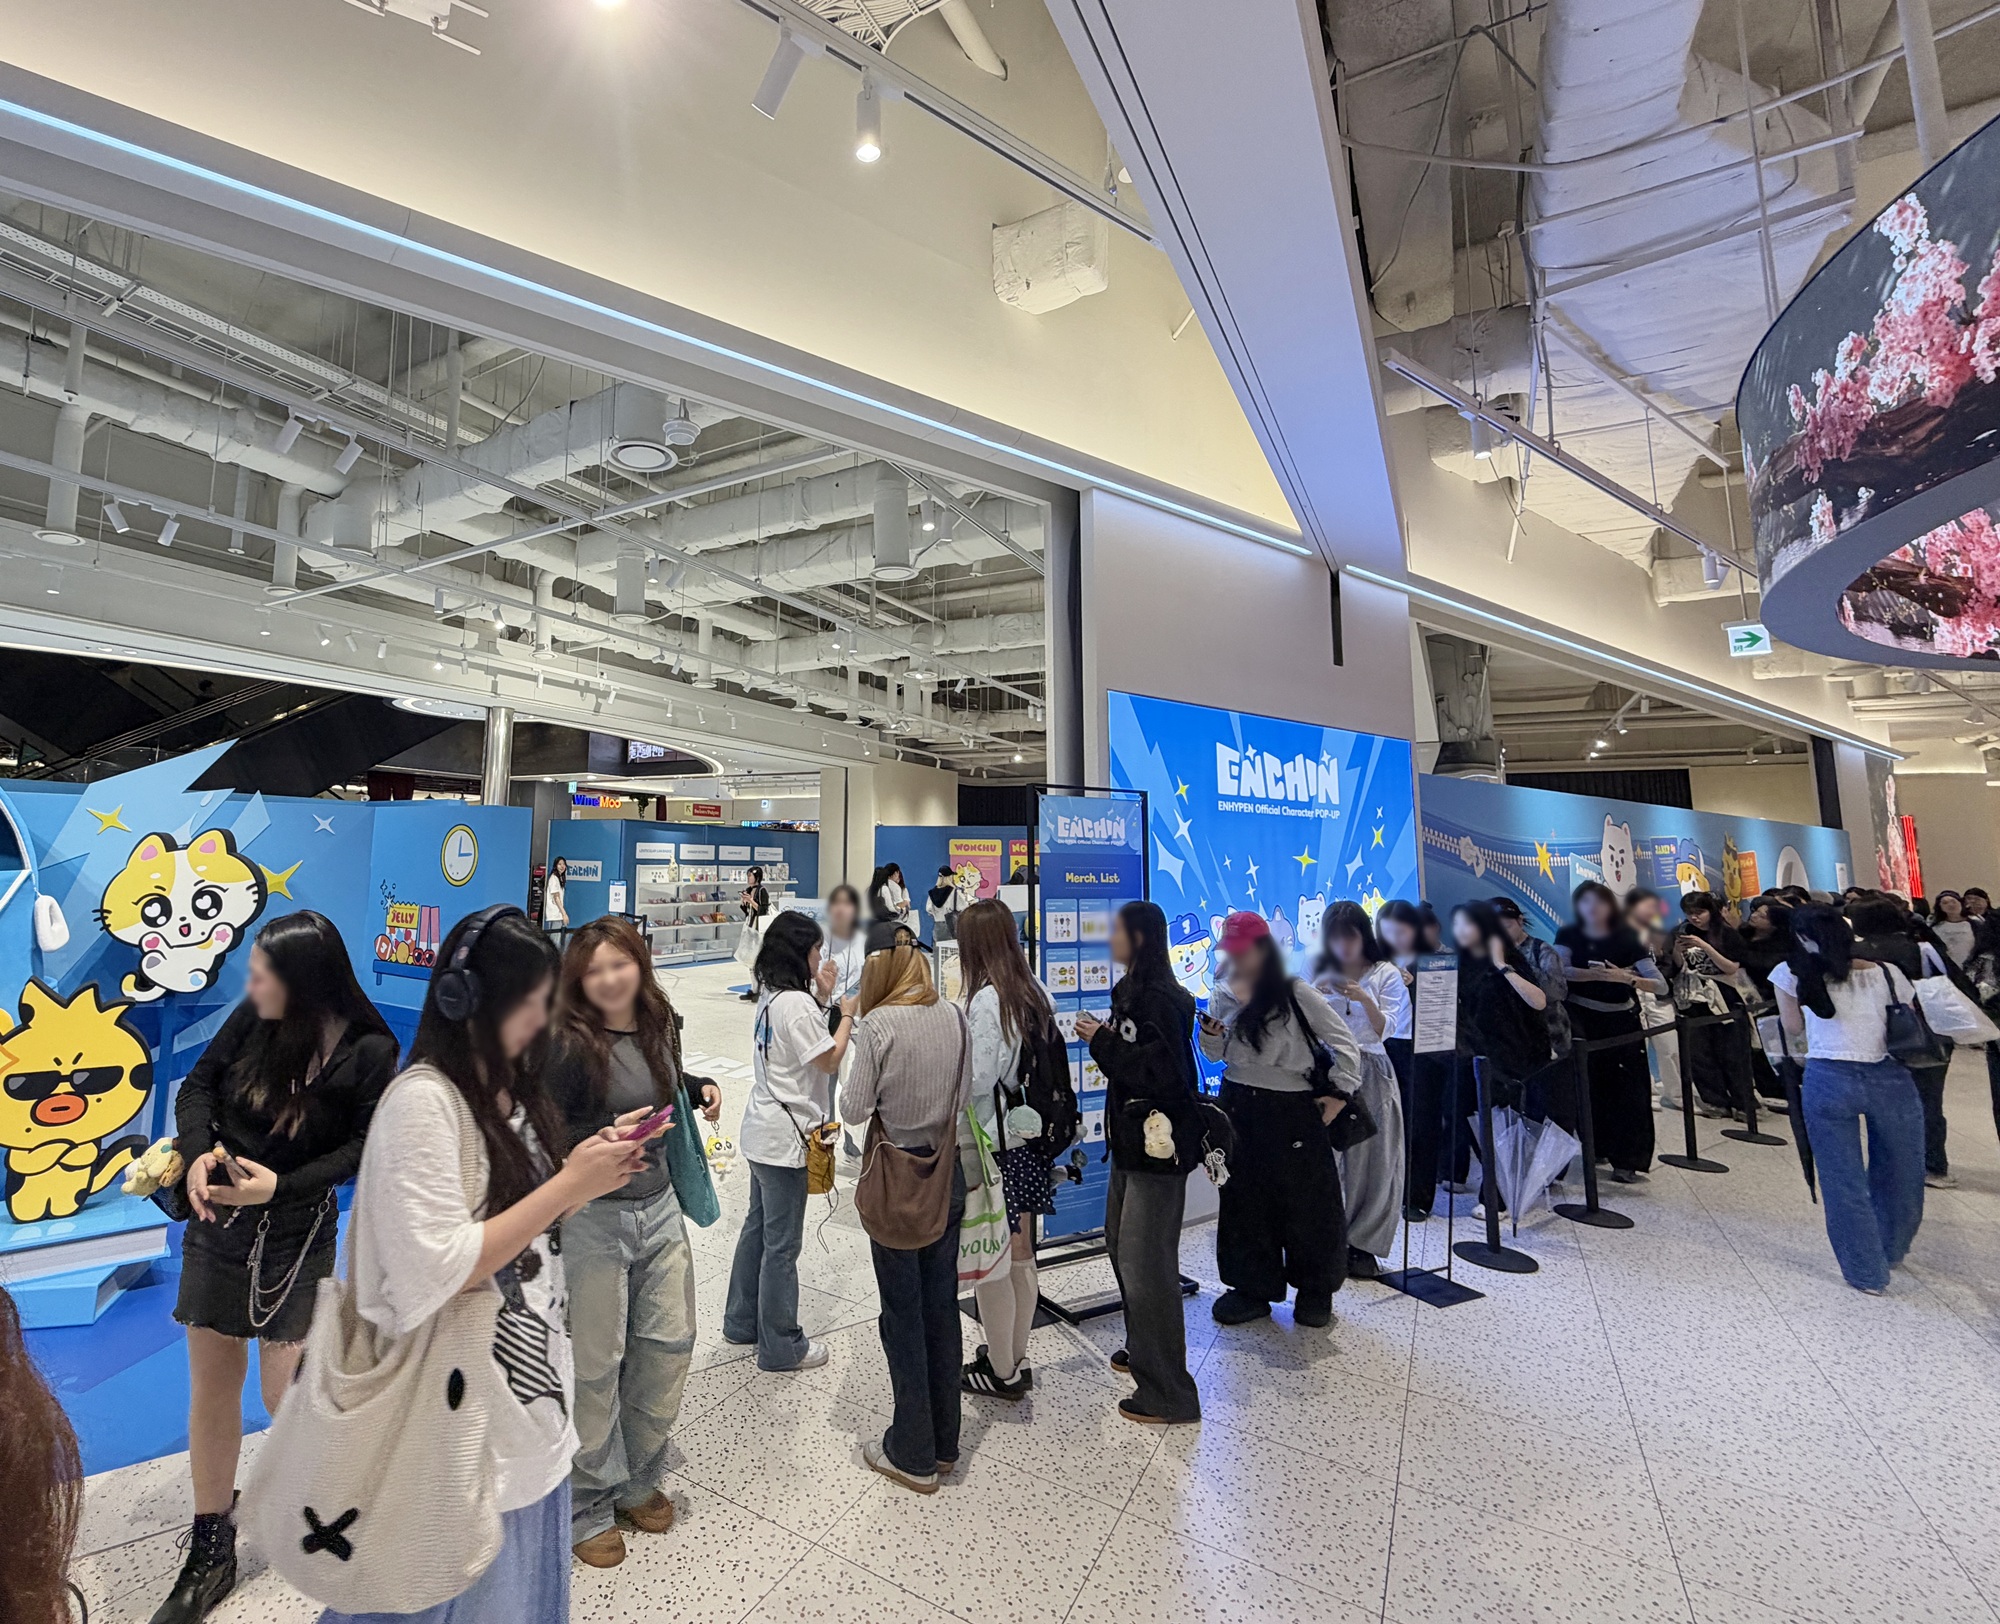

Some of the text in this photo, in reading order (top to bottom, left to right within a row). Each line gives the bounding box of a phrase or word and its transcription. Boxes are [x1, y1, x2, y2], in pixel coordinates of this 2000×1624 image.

[1216, 742, 1340, 805] ENCHIN
[1217, 800, 1340, 820] ENHYPEN Official Character POP-UP
[1057, 815, 1126, 840] ENCHIN
[954, 843, 997, 852] WONCHU
[566, 865, 598, 877] ENCHIN
[1065, 872, 1120, 884] Merch. List
[391, 910, 414, 924] JELLY
